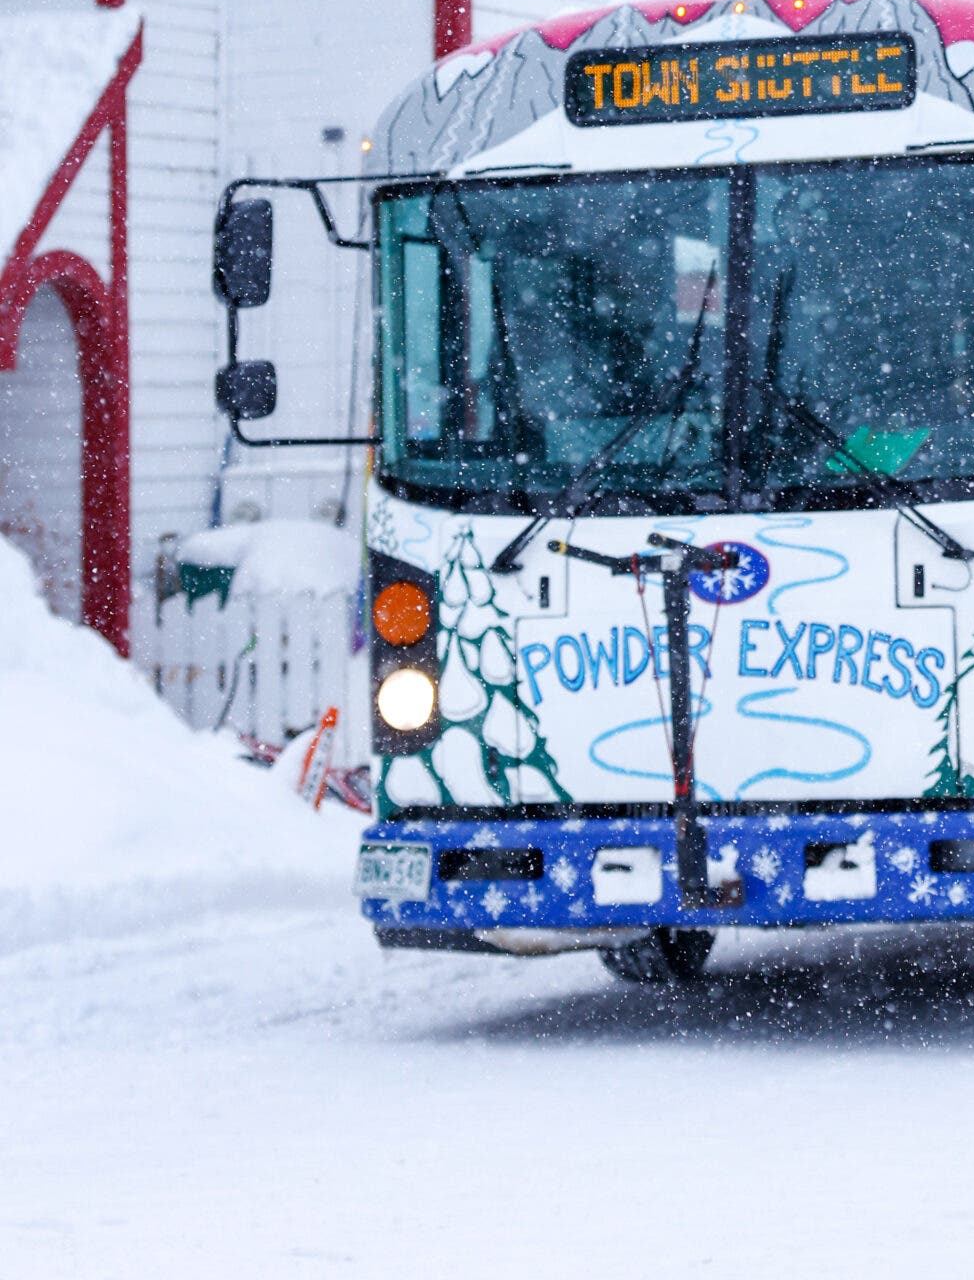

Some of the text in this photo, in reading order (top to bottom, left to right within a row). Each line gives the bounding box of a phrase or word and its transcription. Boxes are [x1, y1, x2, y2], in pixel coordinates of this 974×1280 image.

[584, 47, 903, 109] TOWN SHUTTLE
[738, 620, 945, 708] EXPRESS
